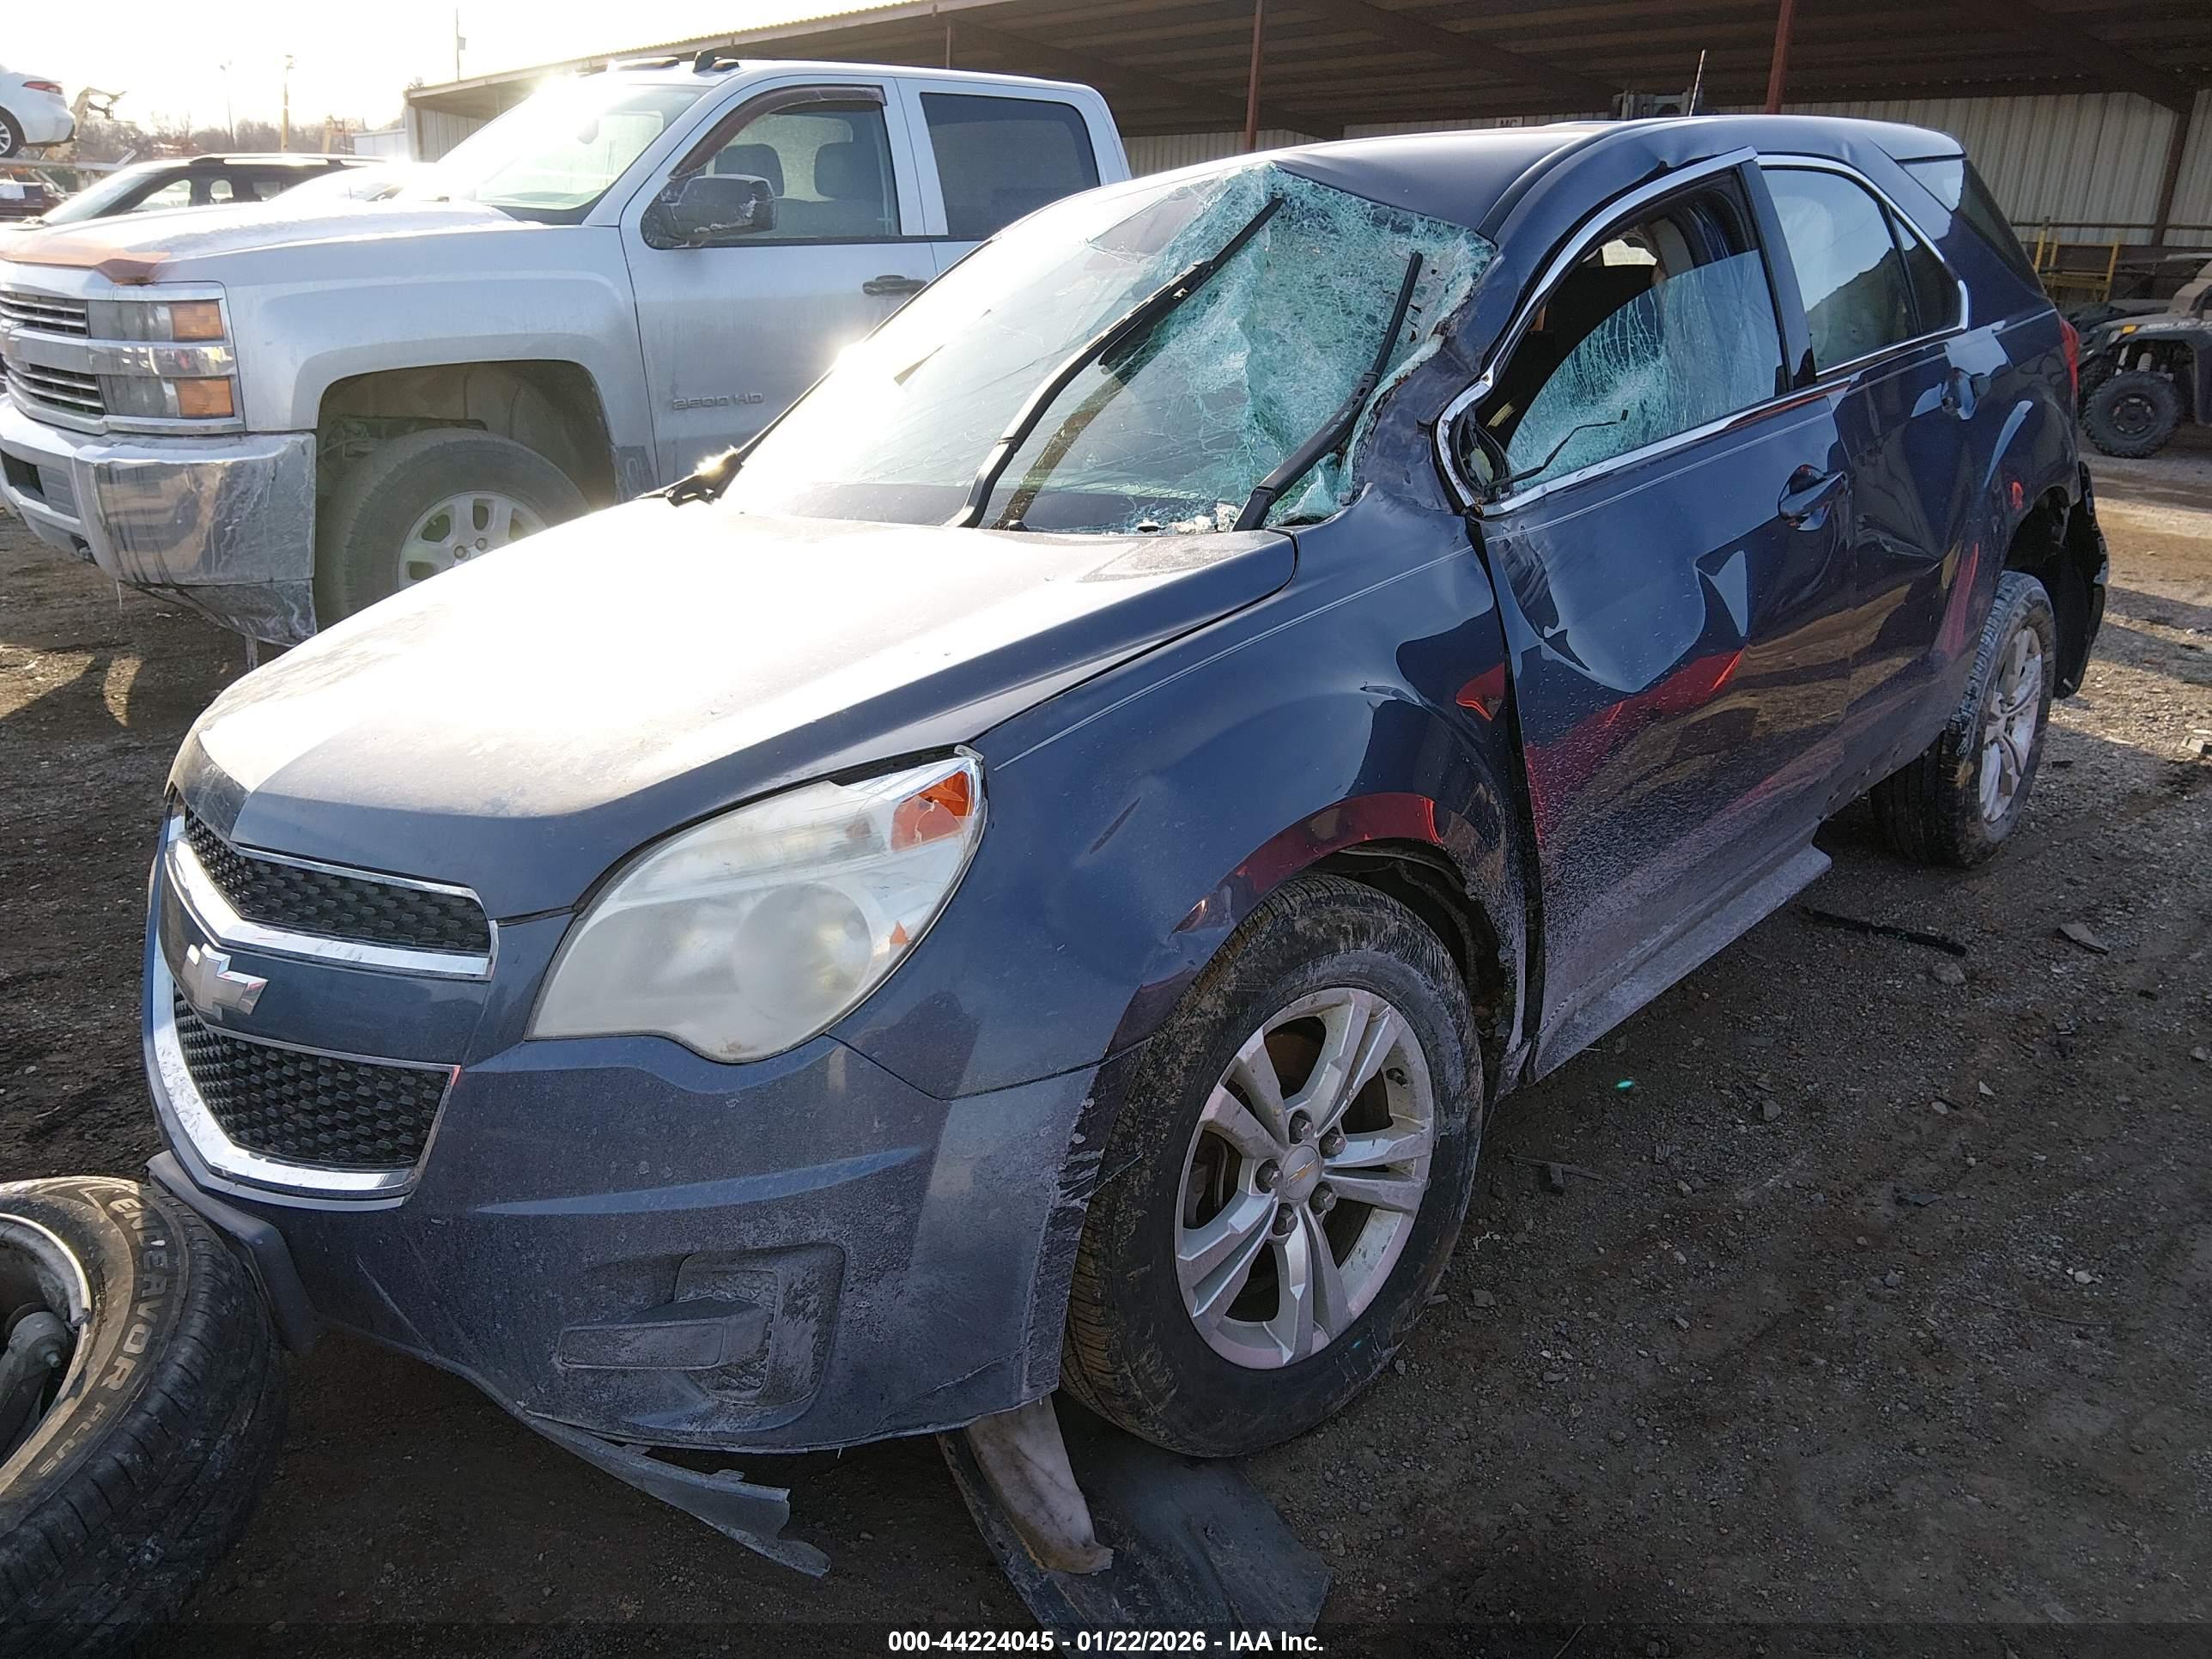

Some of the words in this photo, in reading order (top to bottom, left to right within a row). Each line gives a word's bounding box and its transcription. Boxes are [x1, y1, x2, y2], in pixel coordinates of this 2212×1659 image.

[672, 396, 729, 410] 2500
[734, 392, 764, 405] HD
[100, 1198, 168, 1391] ENDEAVOR
[38, 1401, 106, 1478] PLUS
